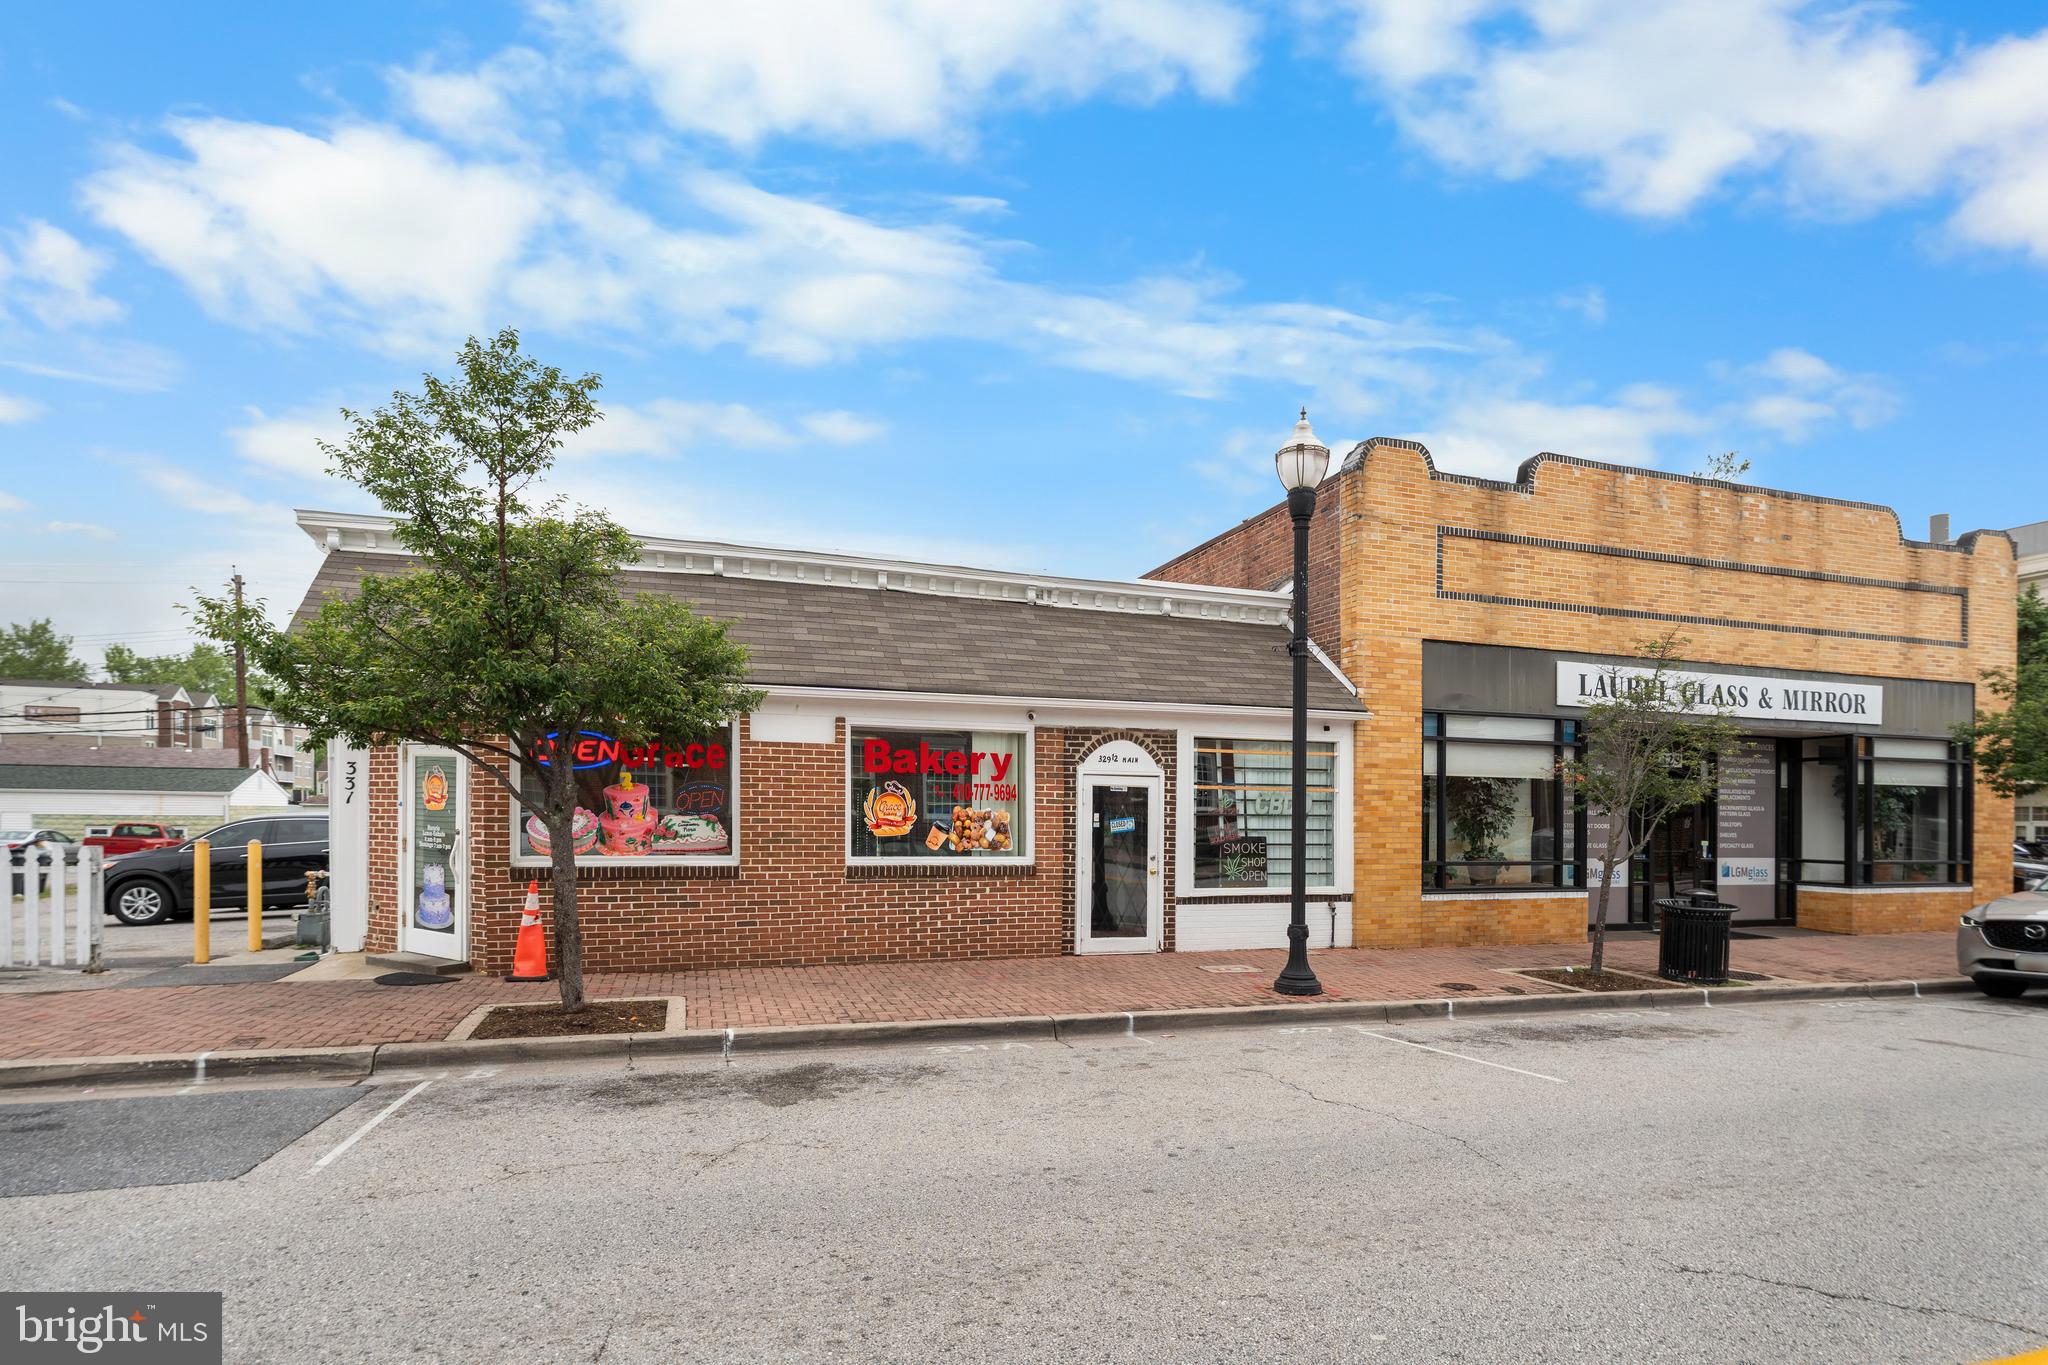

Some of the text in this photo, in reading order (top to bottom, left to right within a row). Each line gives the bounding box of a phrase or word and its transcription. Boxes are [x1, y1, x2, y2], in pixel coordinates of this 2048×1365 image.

[1682, 680, 1749, 708] GLASS
[1759, 687, 1773, 709] &
[1783, 689, 1867, 714] MIRROR
[619, 742, 726, 769] Grace
[863, 739, 1013, 782] Bakery
[677, 790, 725, 810] OPEN
[953, 783, 1017, 801] 410-777-9694
[879, 800, 901, 813] Grace
[1223, 842, 1266, 854] SMOKE
[1241, 857, 1267, 868] SHOP
[1240, 870, 1267, 881] OPEN
[1731, 866, 1769, 880] LGMglass
